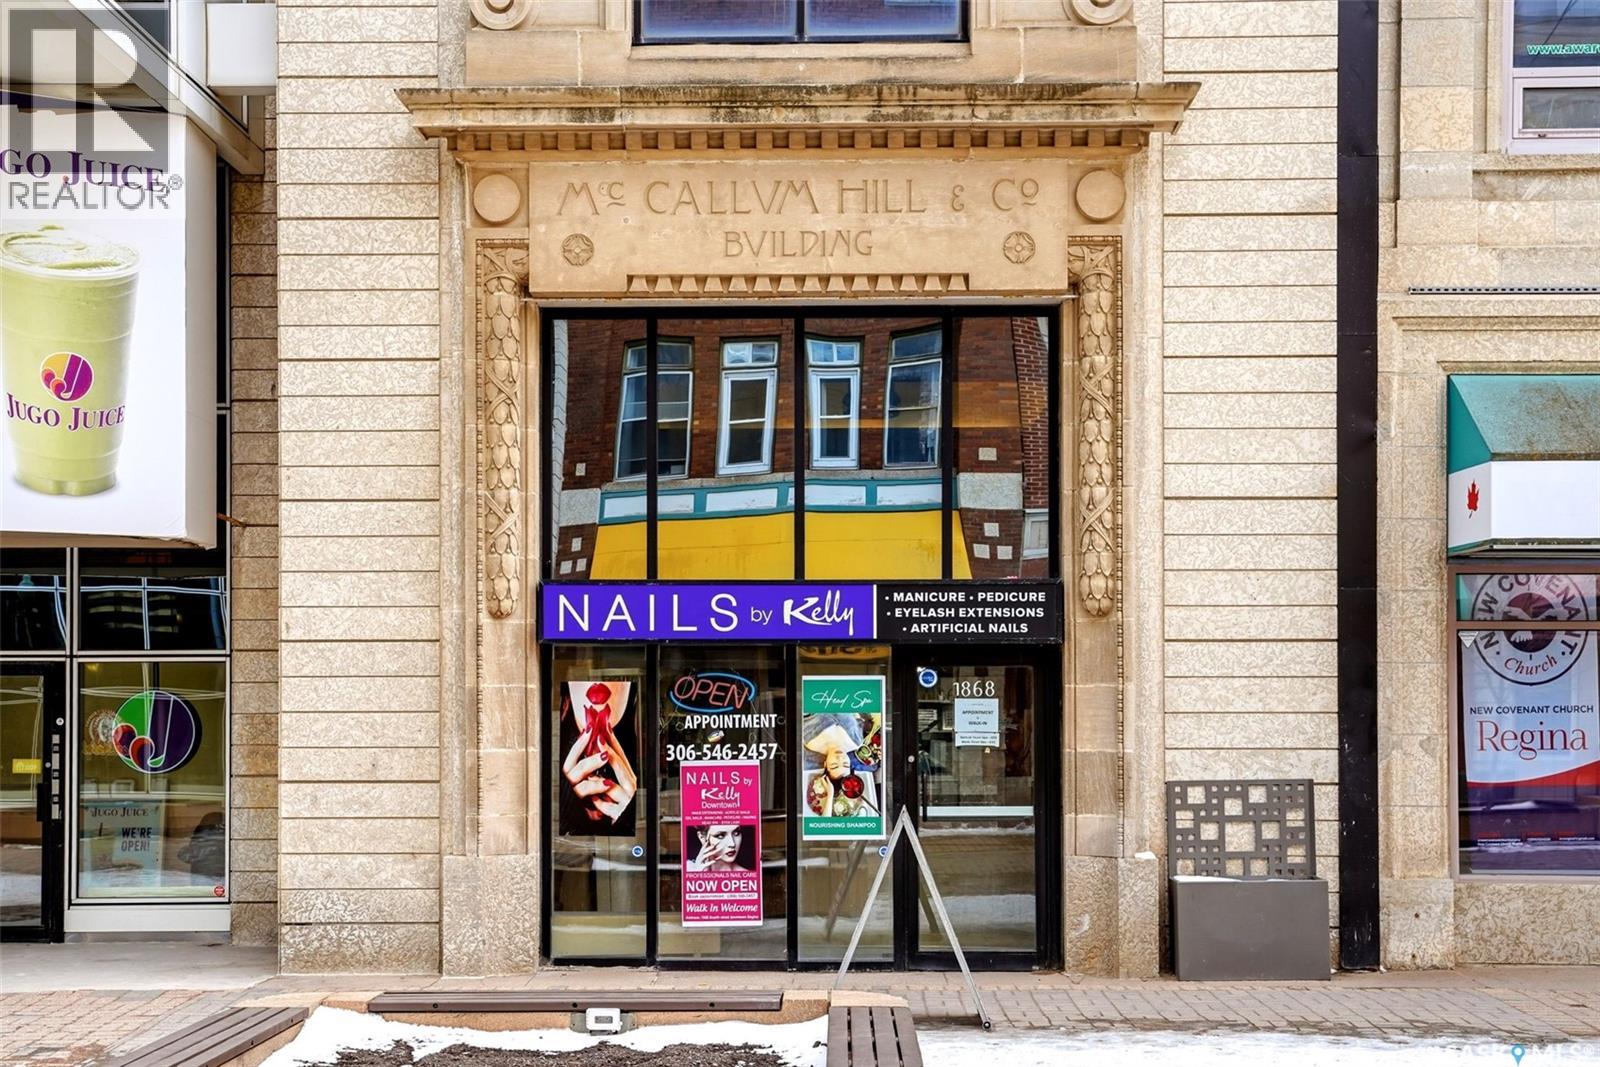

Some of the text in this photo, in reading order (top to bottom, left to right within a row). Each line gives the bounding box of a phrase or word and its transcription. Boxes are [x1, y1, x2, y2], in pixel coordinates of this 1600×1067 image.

[63, 151, 165, 192] JUICE
[837, 178, 926, 214] HILL
[7, 392, 126, 432] JUGO JUICE
[893, 592, 1046, 602] MANICURE PEDICURE
[558, 589, 854, 636] NAILS by Kelly
[895, 608, 1044, 618] EYELASH EXTENSIONS
[910, 623, 1028, 634] ARTIFICIAL NAILS
[1504, 654, 1558, 676] Church
[674, 676, 749, 709] OPEN
[953, 680, 995, 698] 1868
[811, 689, 873, 709] Head Spa
[1470, 704, 1594, 715] NEW COVENANT CHURCH
[684, 714, 778, 729] APPOINTMENT
[1477, 720, 1588, 760] Regina
[666, 743, 778, 761] 306-546-2457
[686, 771, 752, 787] NAILS by
[701, 786, 740, 807] Kelly
[91, 807, 149, 817] JUGO JUICE
[702, 801, 738, 809] Downtown
[121, 827, 152, 839] WE'RE
[121, 840, 150, 852] OPEN!
[686, 880, 757, 892] NOW OPEN
[686, 903, 708, 912] Walk
[721, 902, 758, 912] Welcome
